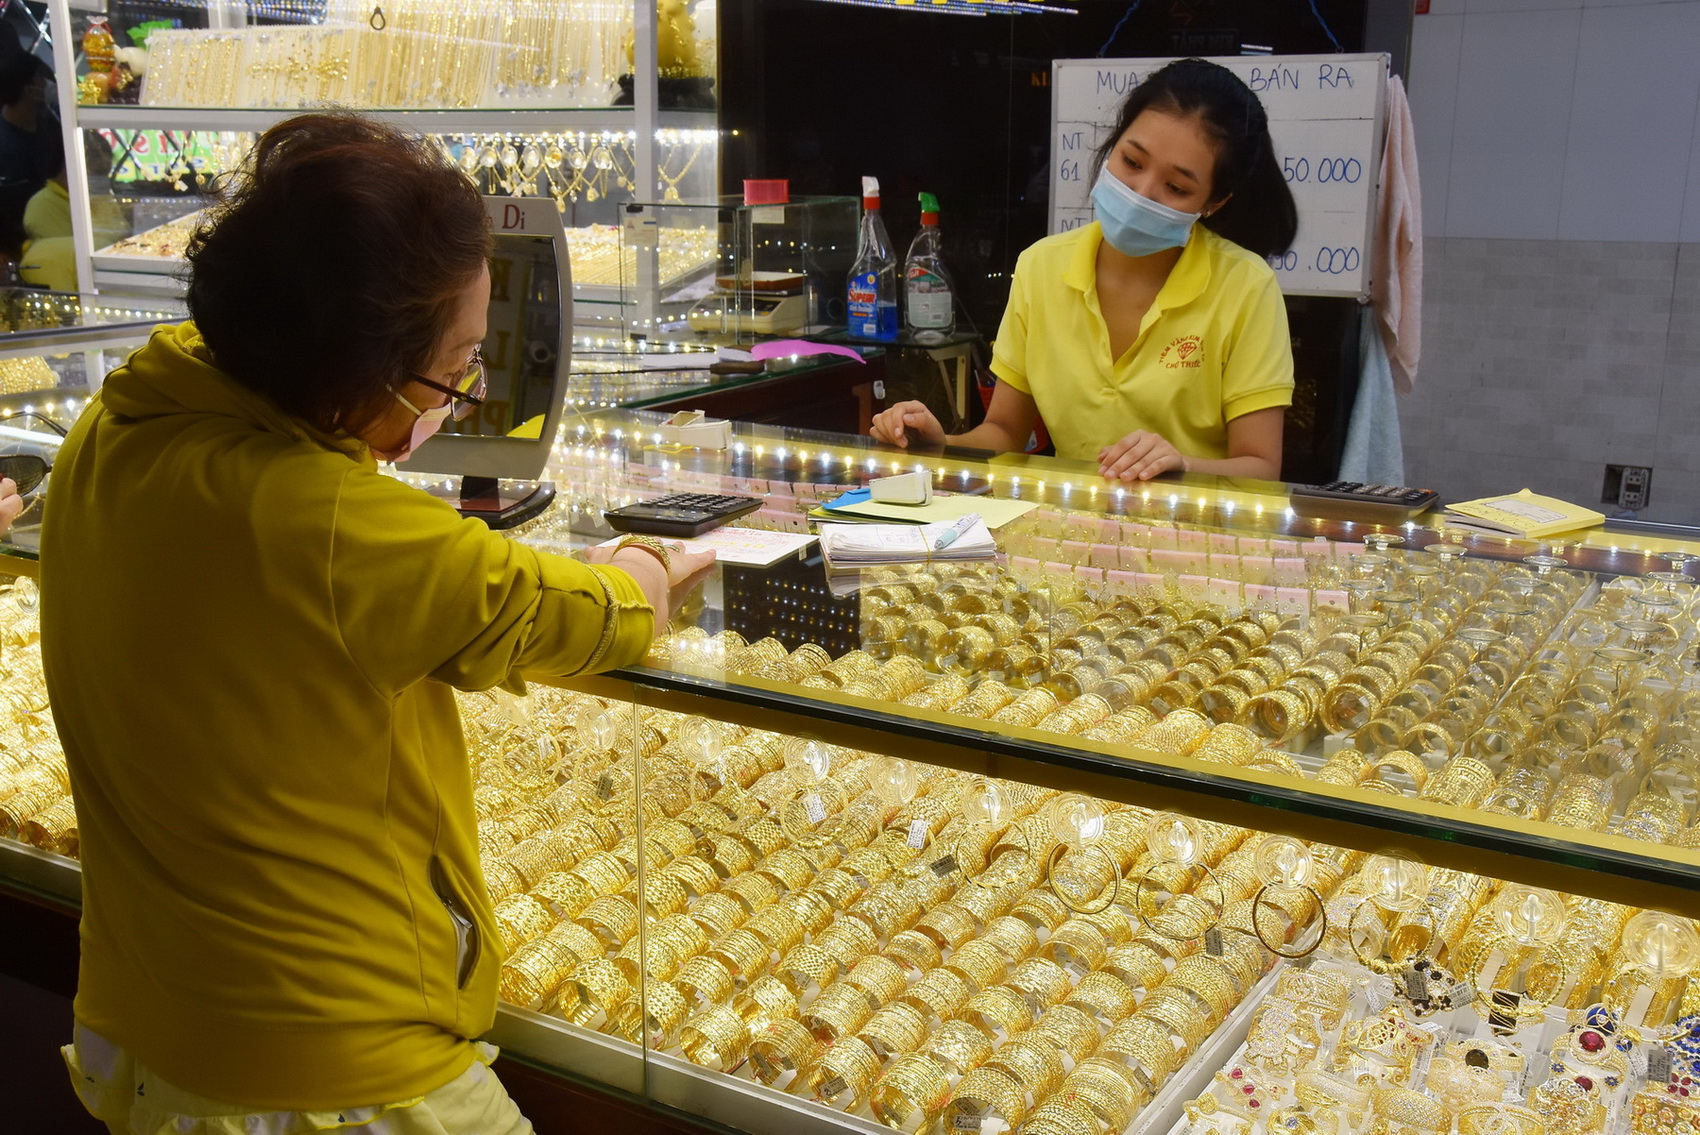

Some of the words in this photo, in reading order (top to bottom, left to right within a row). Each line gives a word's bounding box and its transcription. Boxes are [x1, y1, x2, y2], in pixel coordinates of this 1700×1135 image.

[1097, 71, 1139, 95] MUA
[1250, 63, 1299, 92] BÁN
[1318, 64, 1355, 90] RA
[1062, 132, 1085, 150] NT
[1060, 159, 1081, 181] 61
[502, 204, 526, 230] Di
